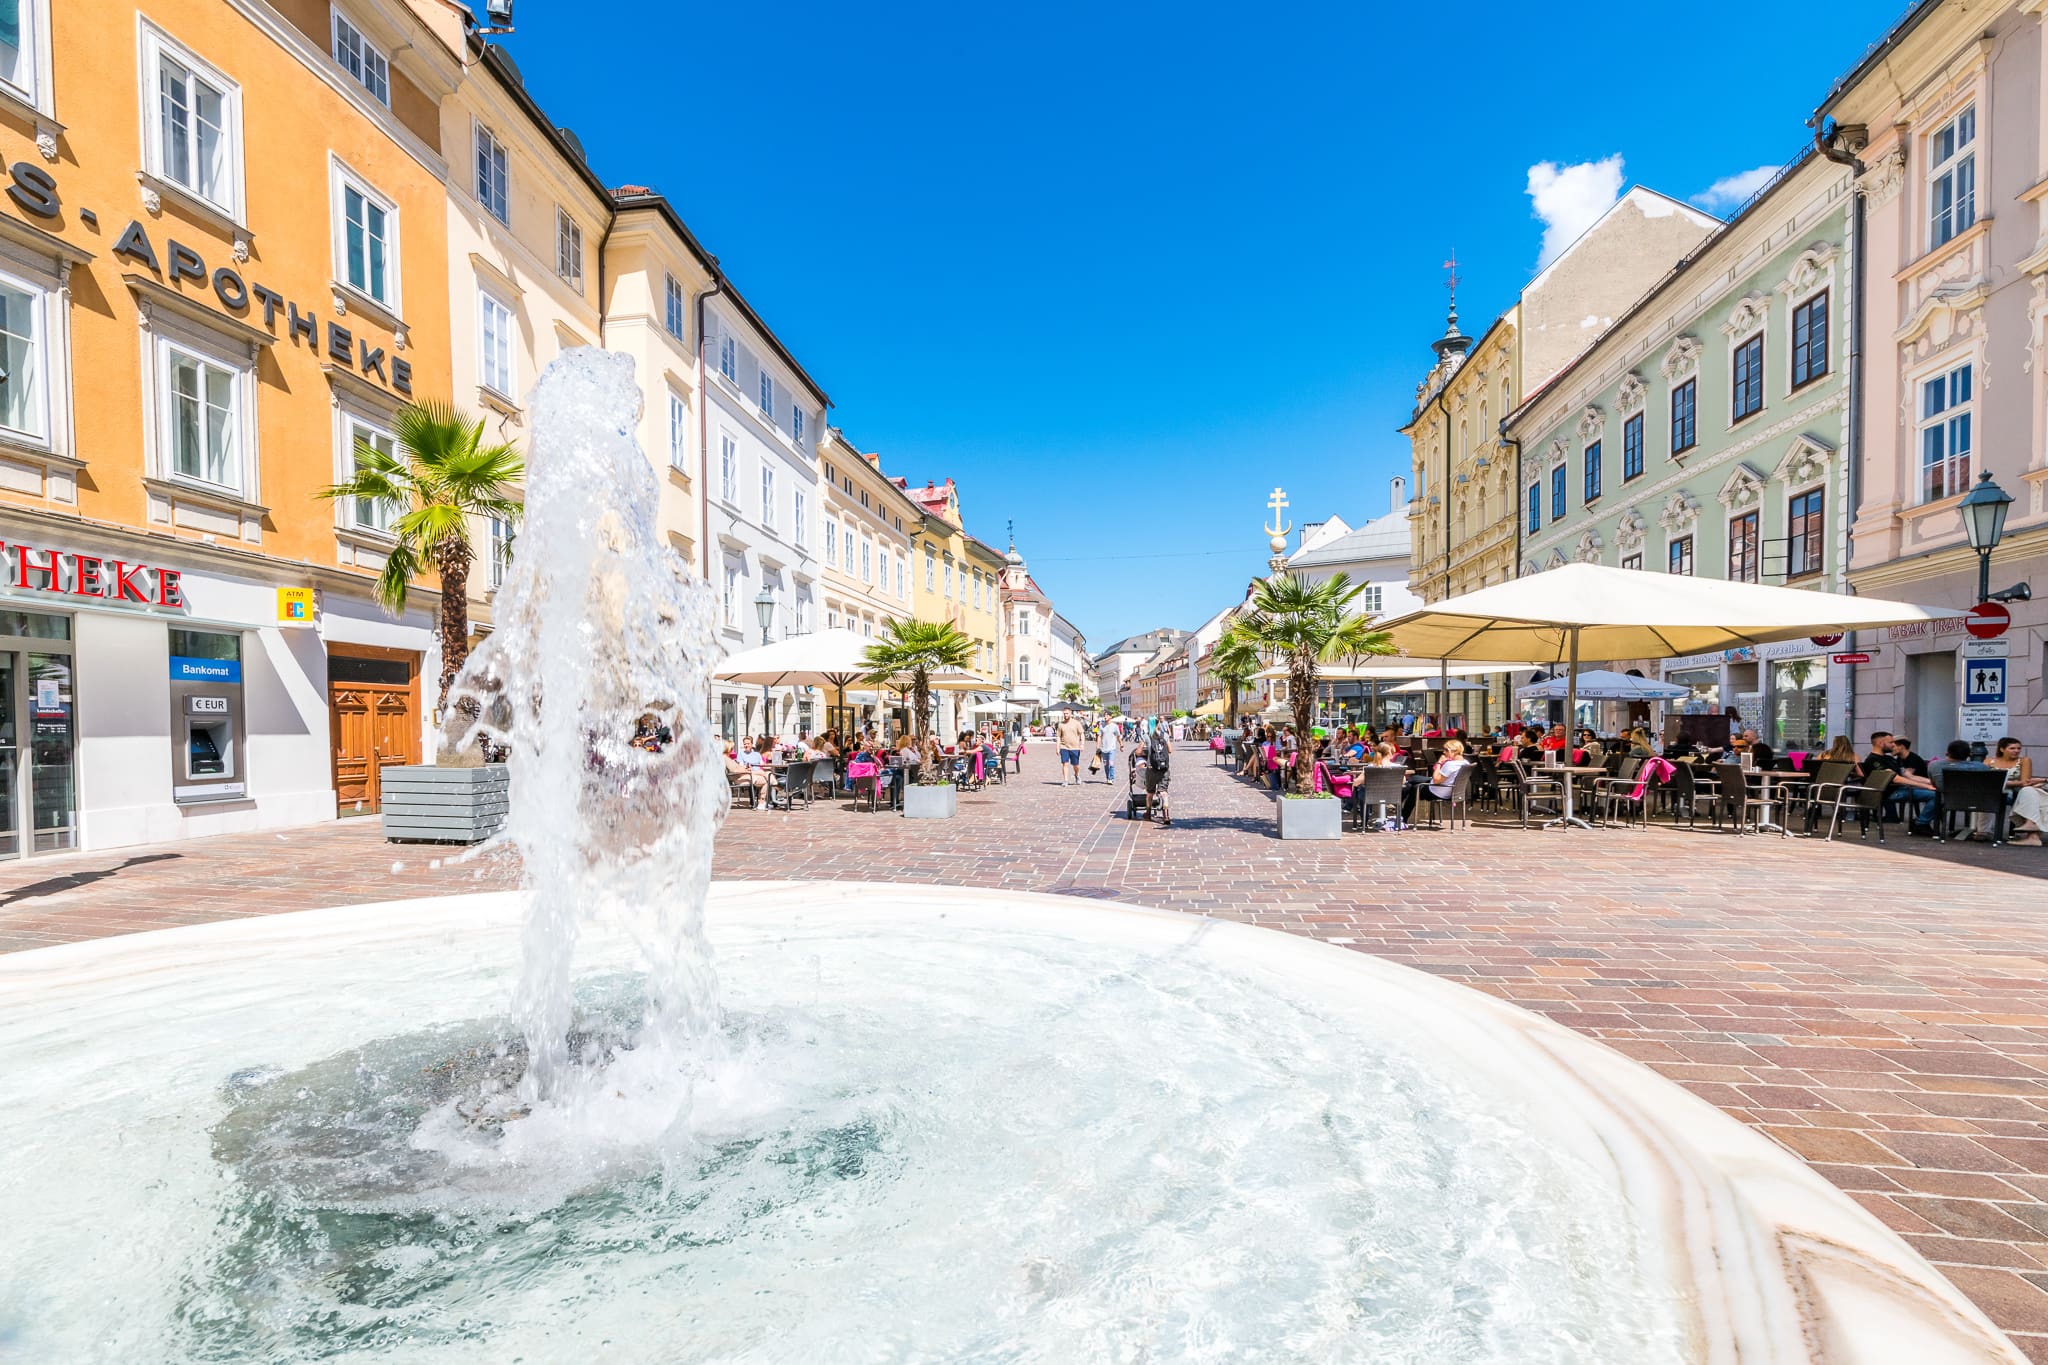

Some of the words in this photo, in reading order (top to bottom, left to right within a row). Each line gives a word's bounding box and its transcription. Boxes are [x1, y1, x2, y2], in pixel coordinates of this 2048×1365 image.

[0, 541, 183, 608] HEKE
[182, 664, 229, 676] Bankomat
[195, 700, 202, 709] €
[205, 700, 224, 710] EUR
